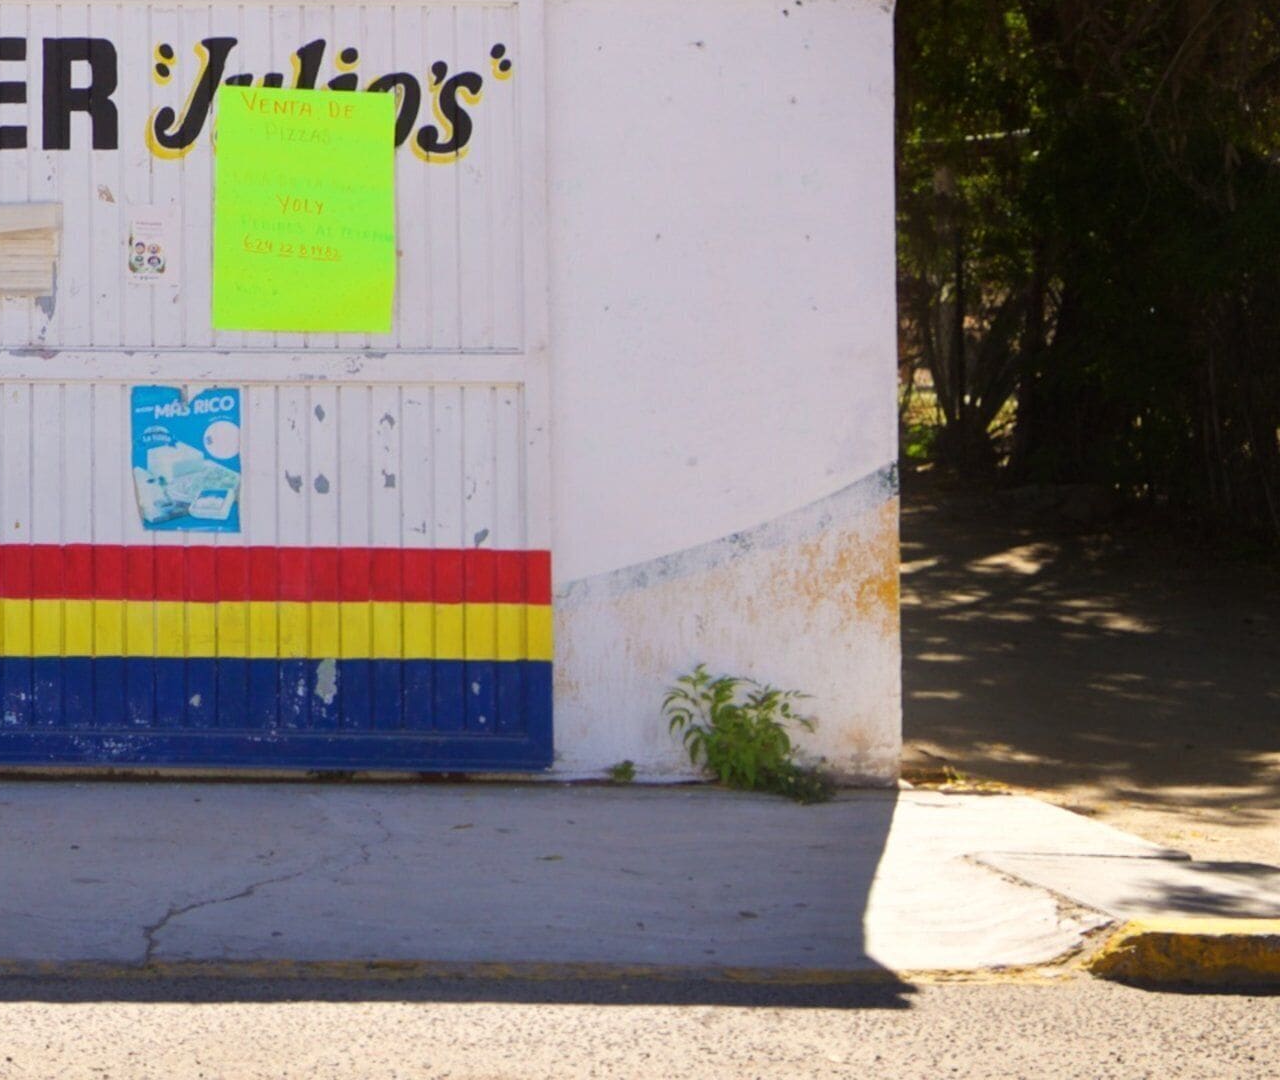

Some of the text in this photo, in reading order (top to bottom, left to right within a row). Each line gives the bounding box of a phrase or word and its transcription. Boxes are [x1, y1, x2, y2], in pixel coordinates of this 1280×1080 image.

[146, 35, 483, 160] Jo's
[241, 91, 355, 120] VENTA DE
[276, 194, 324, 215] YOLY
[193, 395, 235, 415] RICO
